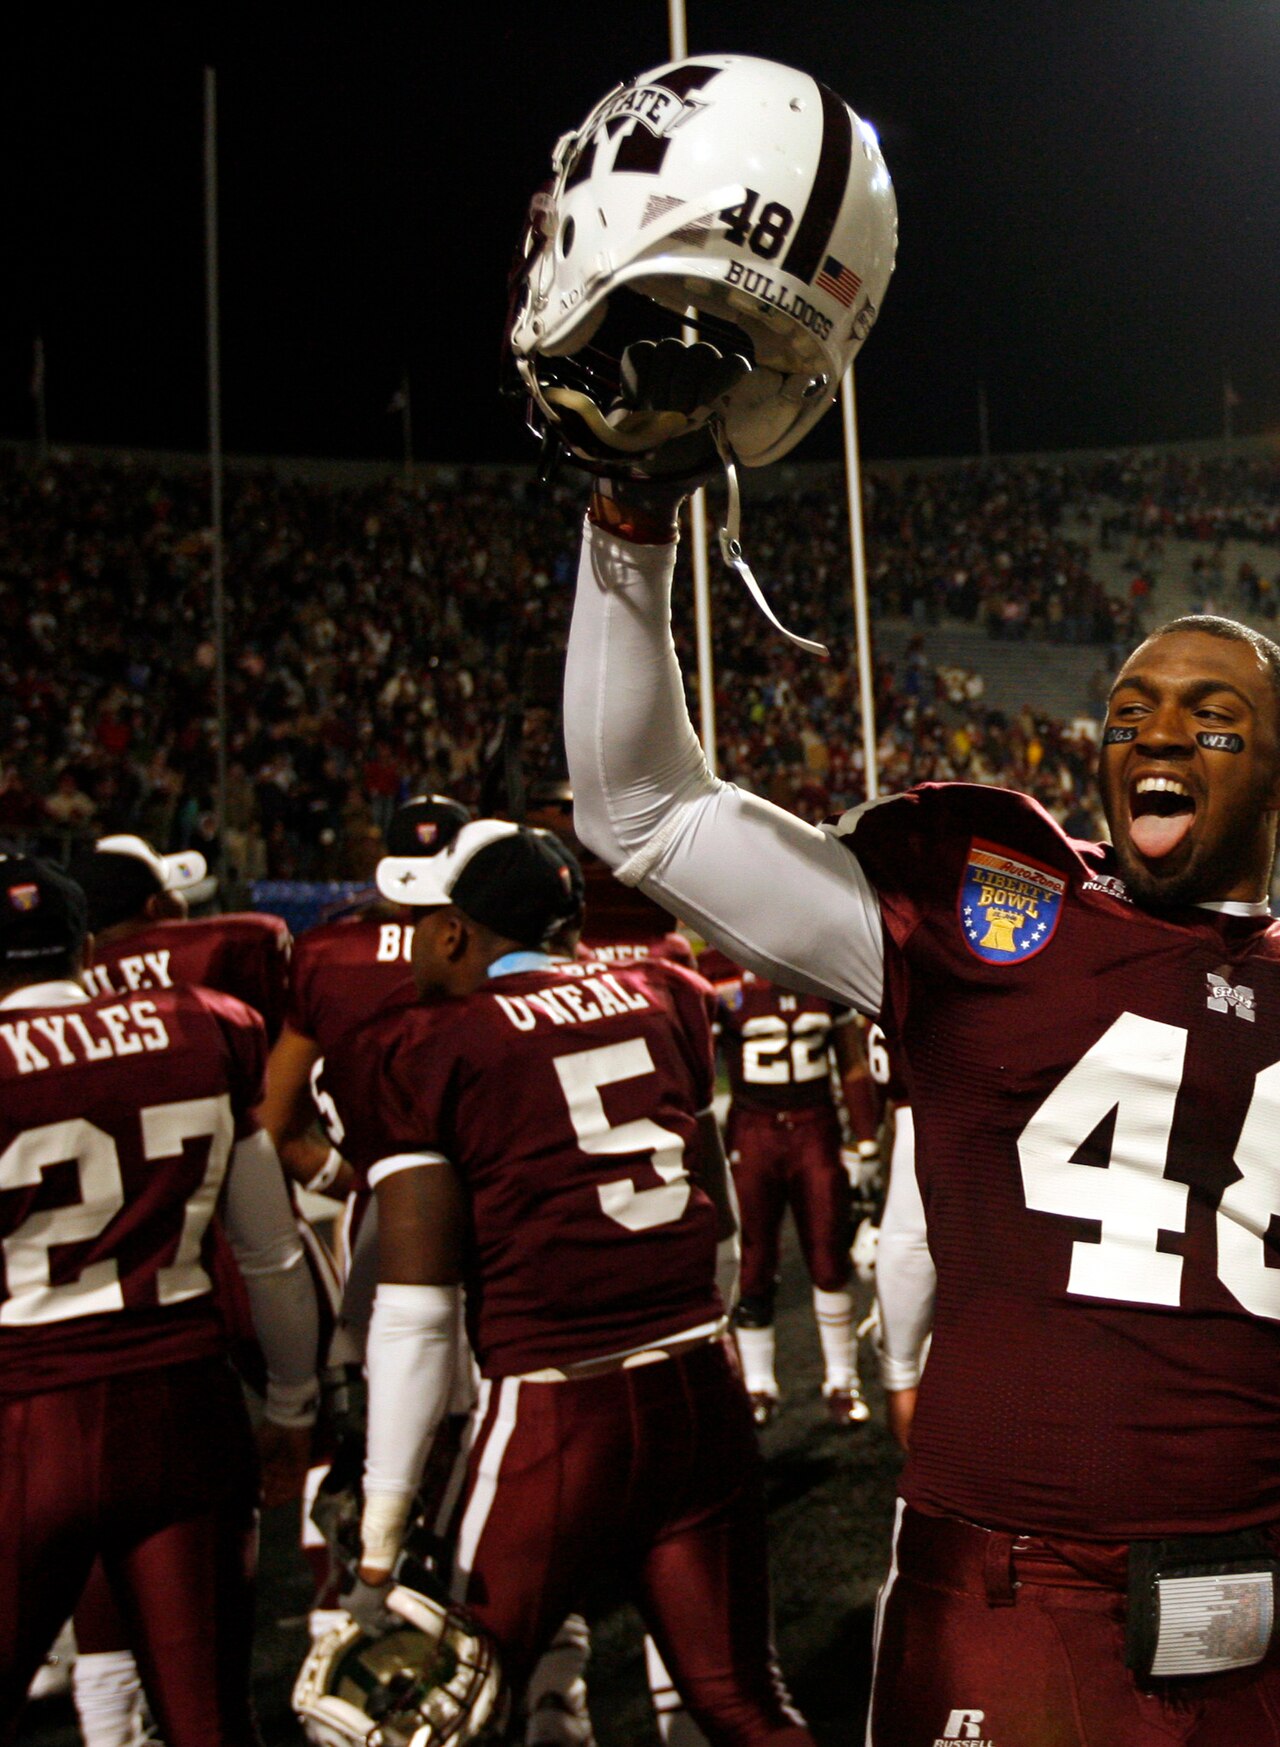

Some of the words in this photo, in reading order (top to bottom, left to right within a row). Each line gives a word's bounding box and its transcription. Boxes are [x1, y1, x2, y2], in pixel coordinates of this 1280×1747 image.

[719, 188, 794, 260] 48
[724, 260, 834, 341] BULLDOGS
[1202, 734, 1241, 750] WIN
[972, 868, 1055, 903] LIBERTY
[977, 885, 1039, 919] BOWL
[2, 1000, 170, 1074] KYLES
[741, 1012, 832, 1084] 22
[553, 1037, 691, 1231] 5
[0, 1094, 236, 1327] 27
